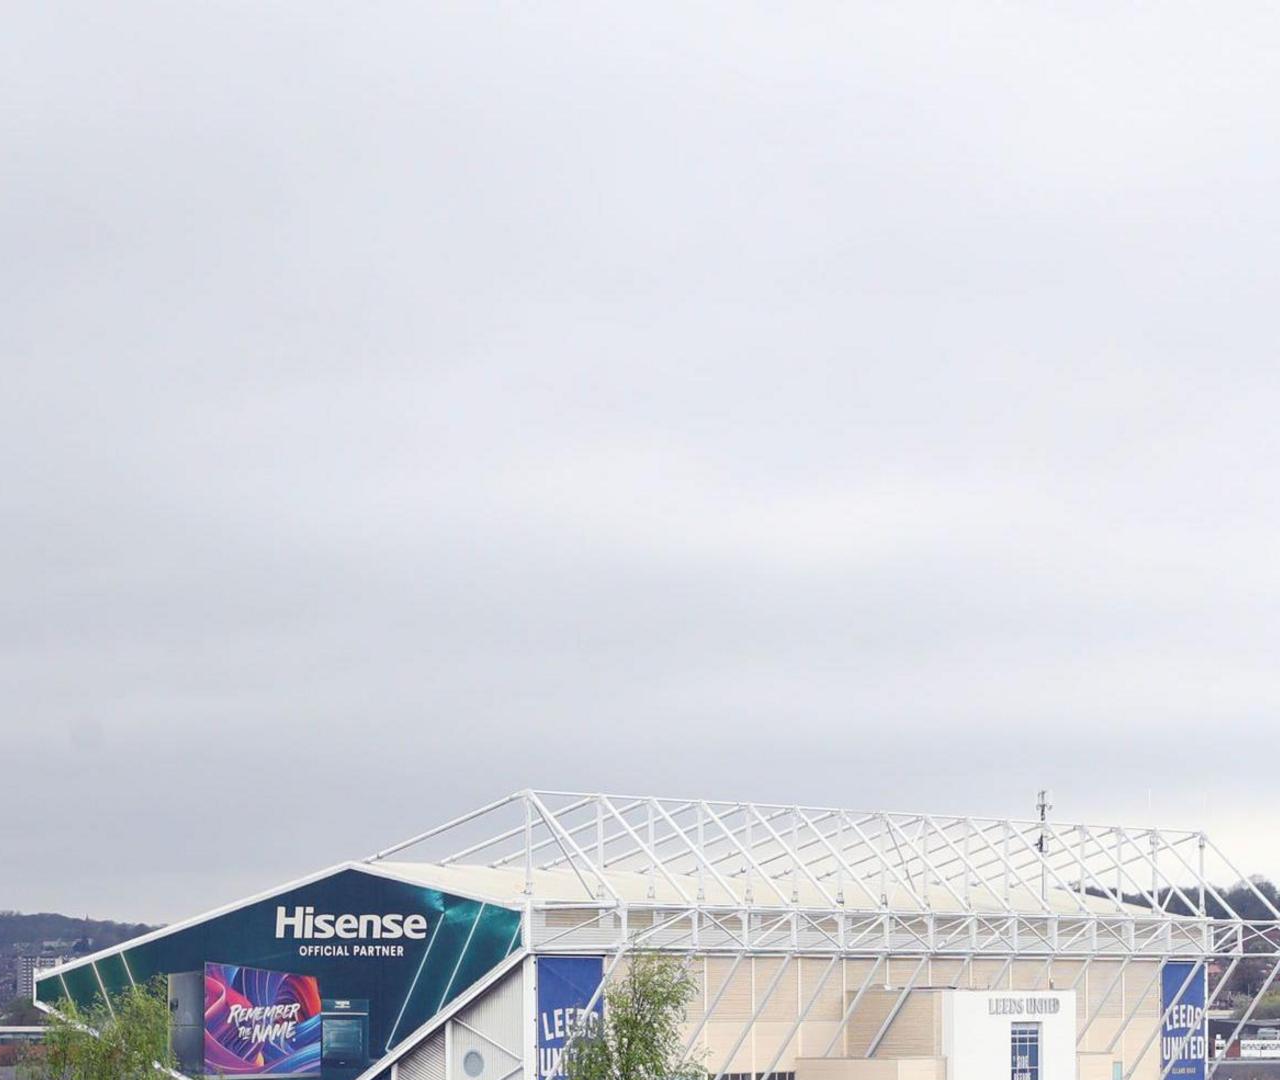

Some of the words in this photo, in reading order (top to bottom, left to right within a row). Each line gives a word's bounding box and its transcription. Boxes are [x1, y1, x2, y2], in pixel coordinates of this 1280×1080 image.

[275, 906, 428, 939] Hisense
[299, 945, 349, 957] OFFICIAL
[353, 945, 404, 957] PARTNER
[227, 1003, 300, 1024] REMEMBER
[987, 998, 1024, 1015] LEEDS
[1026, 998, 1060, 1014] UNITED
[1166, 1004, 1203, 1031] LEEDS
[238, 1026, 252, 1040] THE
[1163, 1036, 1205, 1060] UNITED
